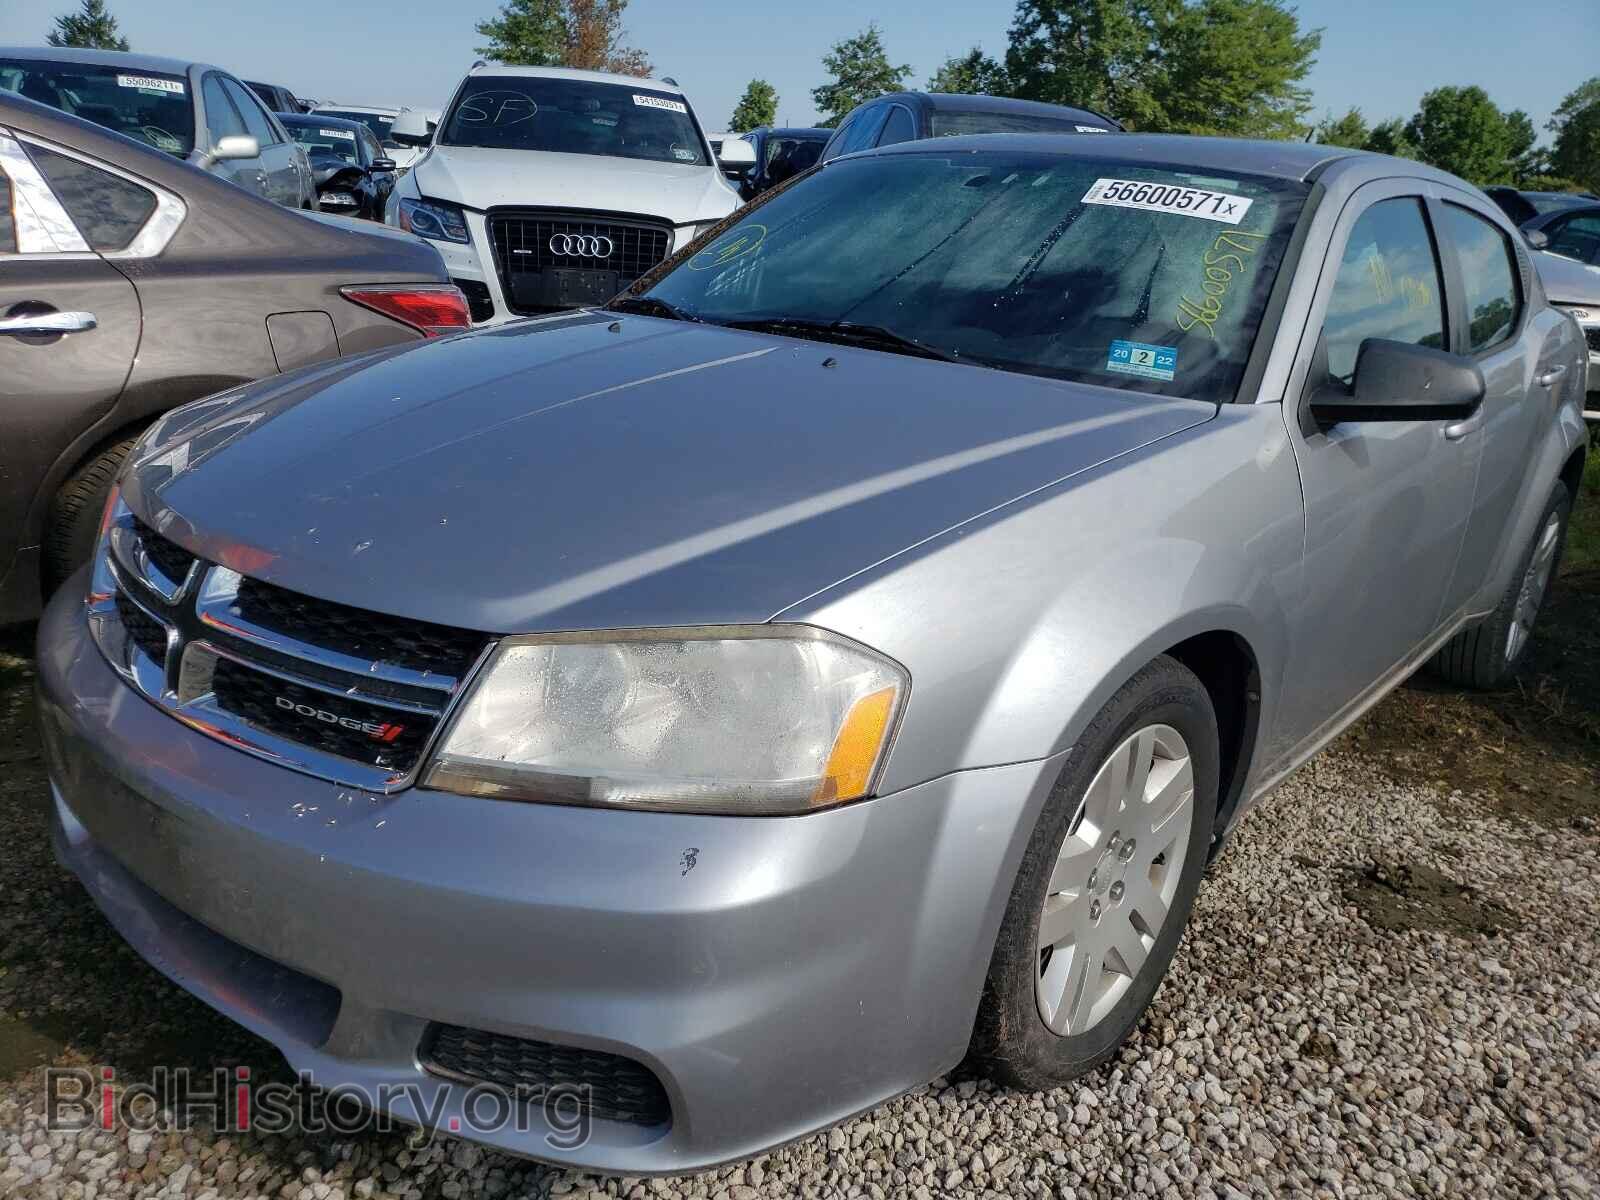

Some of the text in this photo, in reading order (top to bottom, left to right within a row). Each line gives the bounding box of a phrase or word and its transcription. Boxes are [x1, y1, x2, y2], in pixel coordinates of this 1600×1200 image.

[461, 97, 529, 125] SF
[1112, 348, 1173, 366] 20 2 22
[275, 696, 385, 737] DODGE
